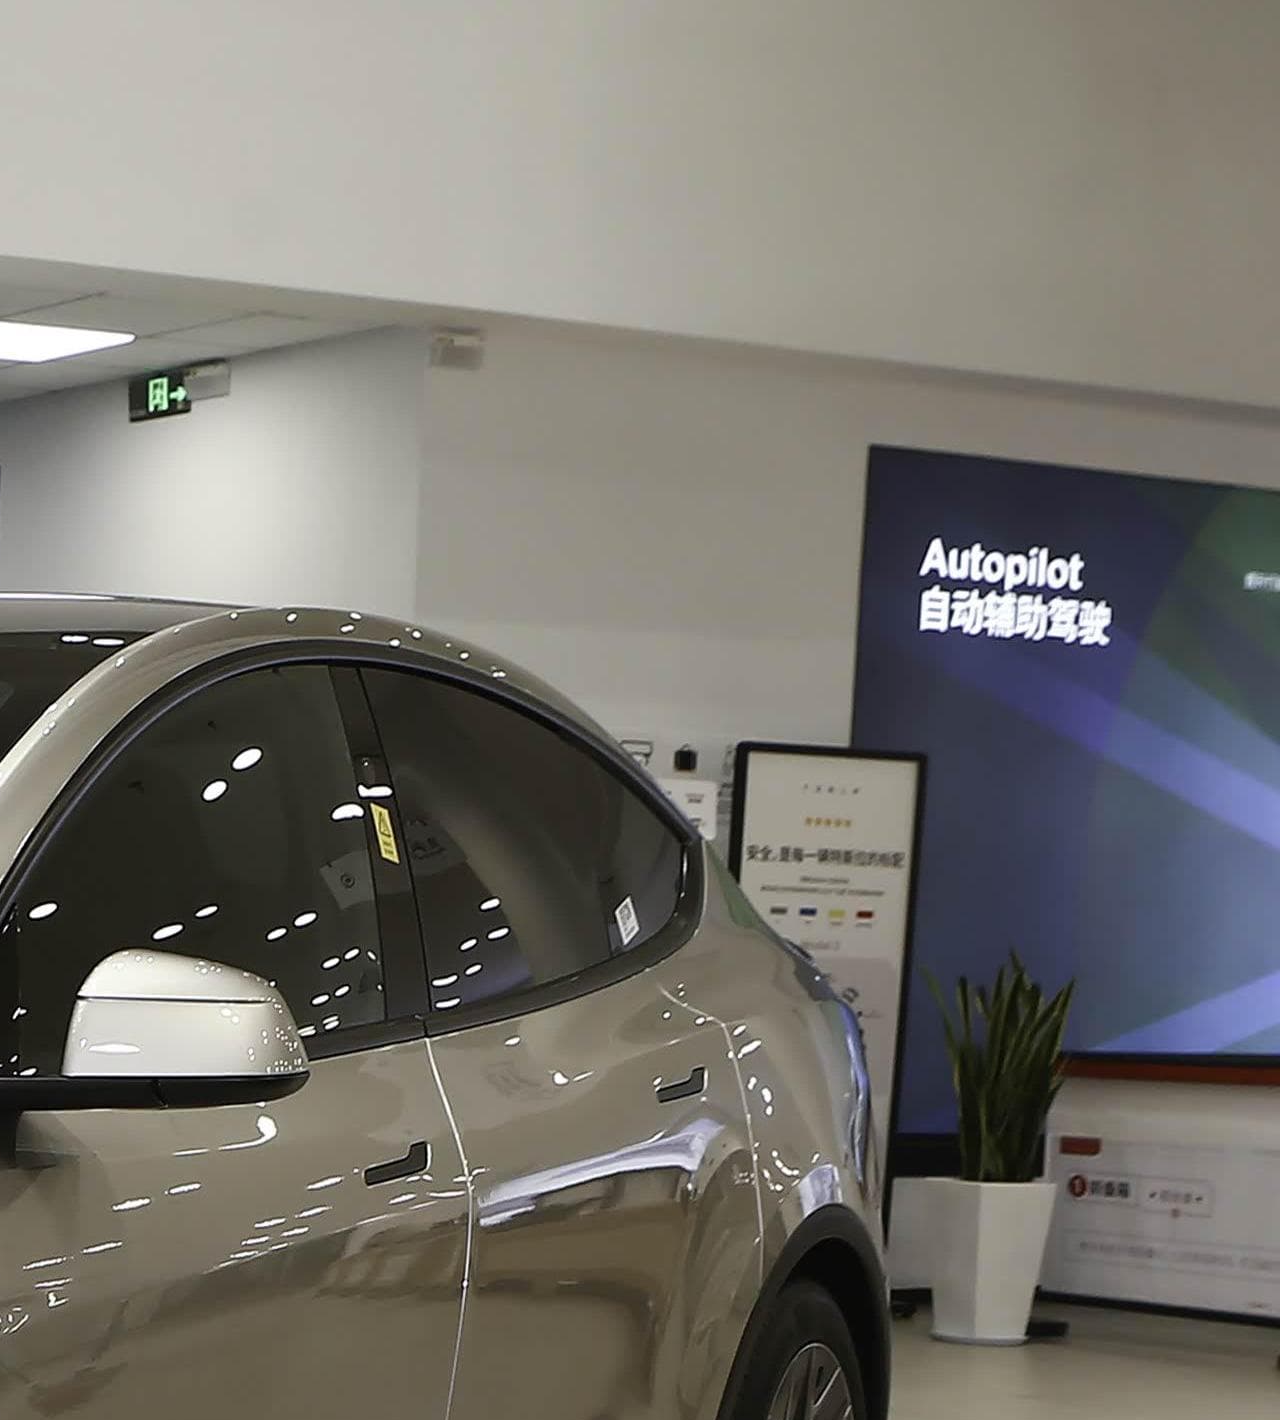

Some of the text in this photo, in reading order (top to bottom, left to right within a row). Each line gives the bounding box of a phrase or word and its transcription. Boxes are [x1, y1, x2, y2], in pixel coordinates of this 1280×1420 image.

[920, 537, 1085, 591] Autopilot
[920, 584, 1112, 645] 自动辅助驾驶
